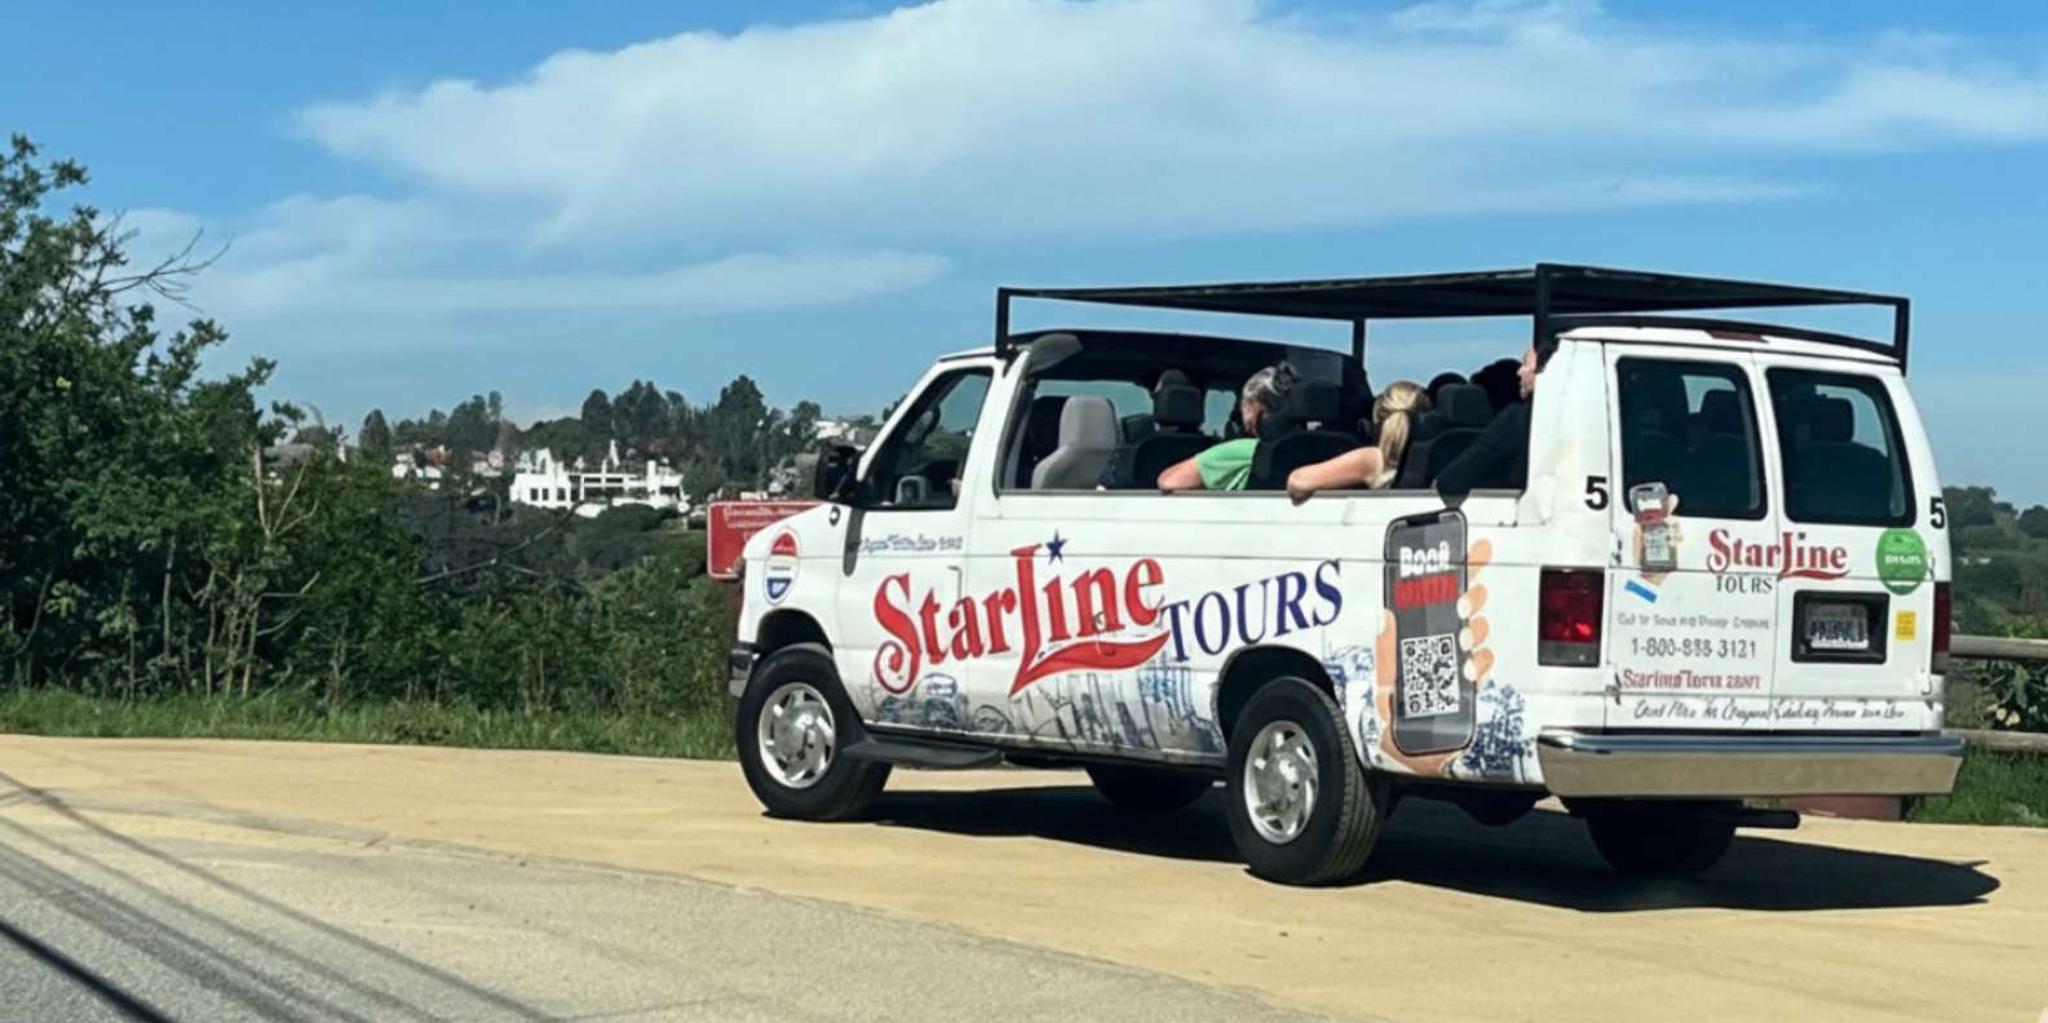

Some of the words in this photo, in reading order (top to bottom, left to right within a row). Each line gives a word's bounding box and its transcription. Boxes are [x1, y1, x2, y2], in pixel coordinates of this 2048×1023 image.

[1585, 475, 1609, 511] 5
[1930, 496, 1945, 529] 5
[1716, 575, 1773, 594] TOURS
[1160, 558, 1344, 664] TOURS
